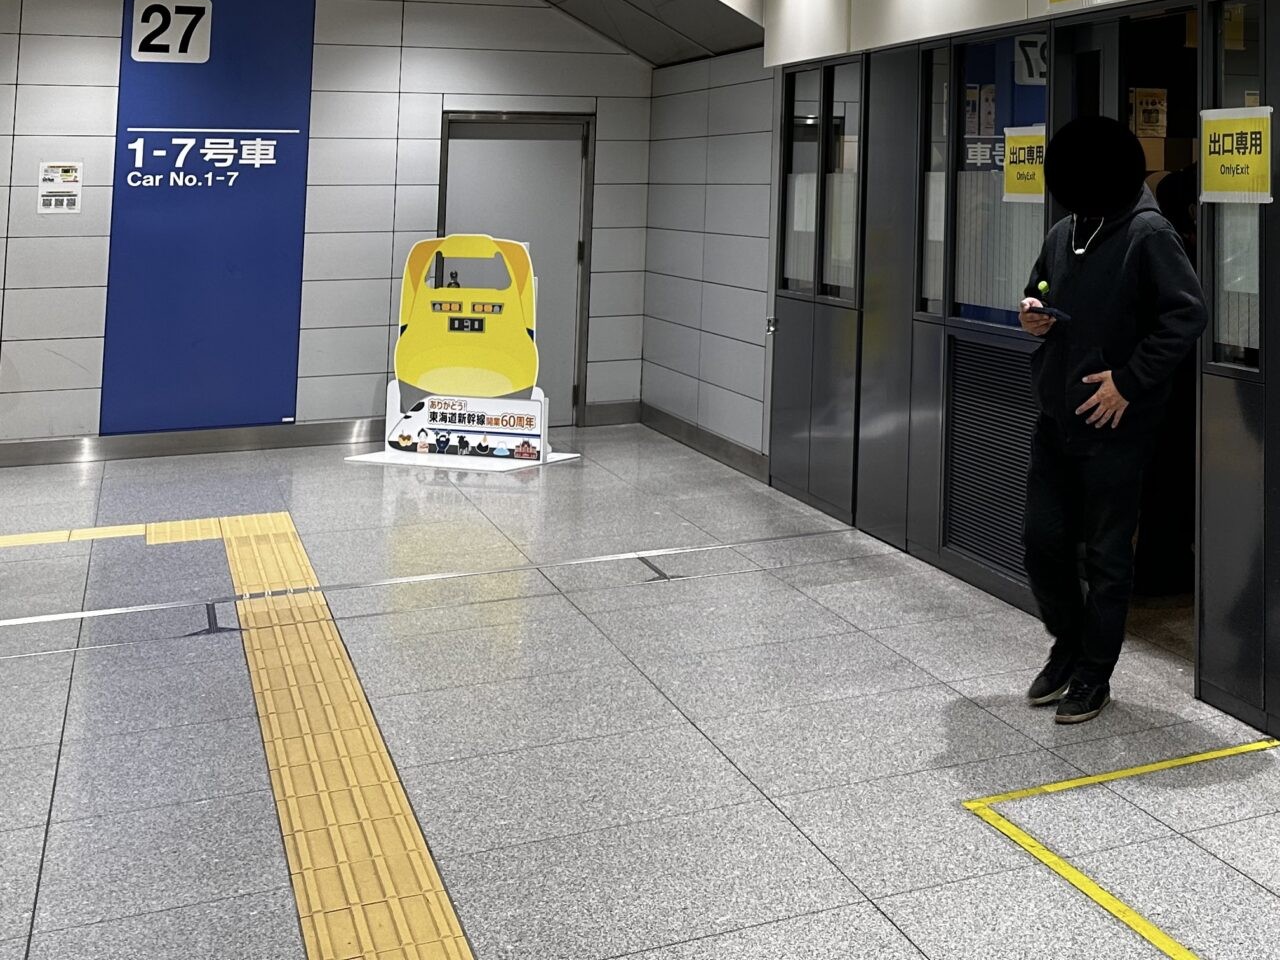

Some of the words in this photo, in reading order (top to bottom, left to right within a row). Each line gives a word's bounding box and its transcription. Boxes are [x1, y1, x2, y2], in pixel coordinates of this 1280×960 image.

[138, 4, 206, 54] 27
[127, 137, 277, 168] 1-7号車
[1208, 131, 1262, 156] 出口専用
[1009, 145, 1044, 165] 出口専用
[127, 171, 163, 187] Car
[169, 171, 240, 187] No.1-7
[1016, 171, 1036, 181] OnlyExit
[1220, 164, 1250, 177] OnlyExit
[429, 400, 466, 411] ありがとう!
